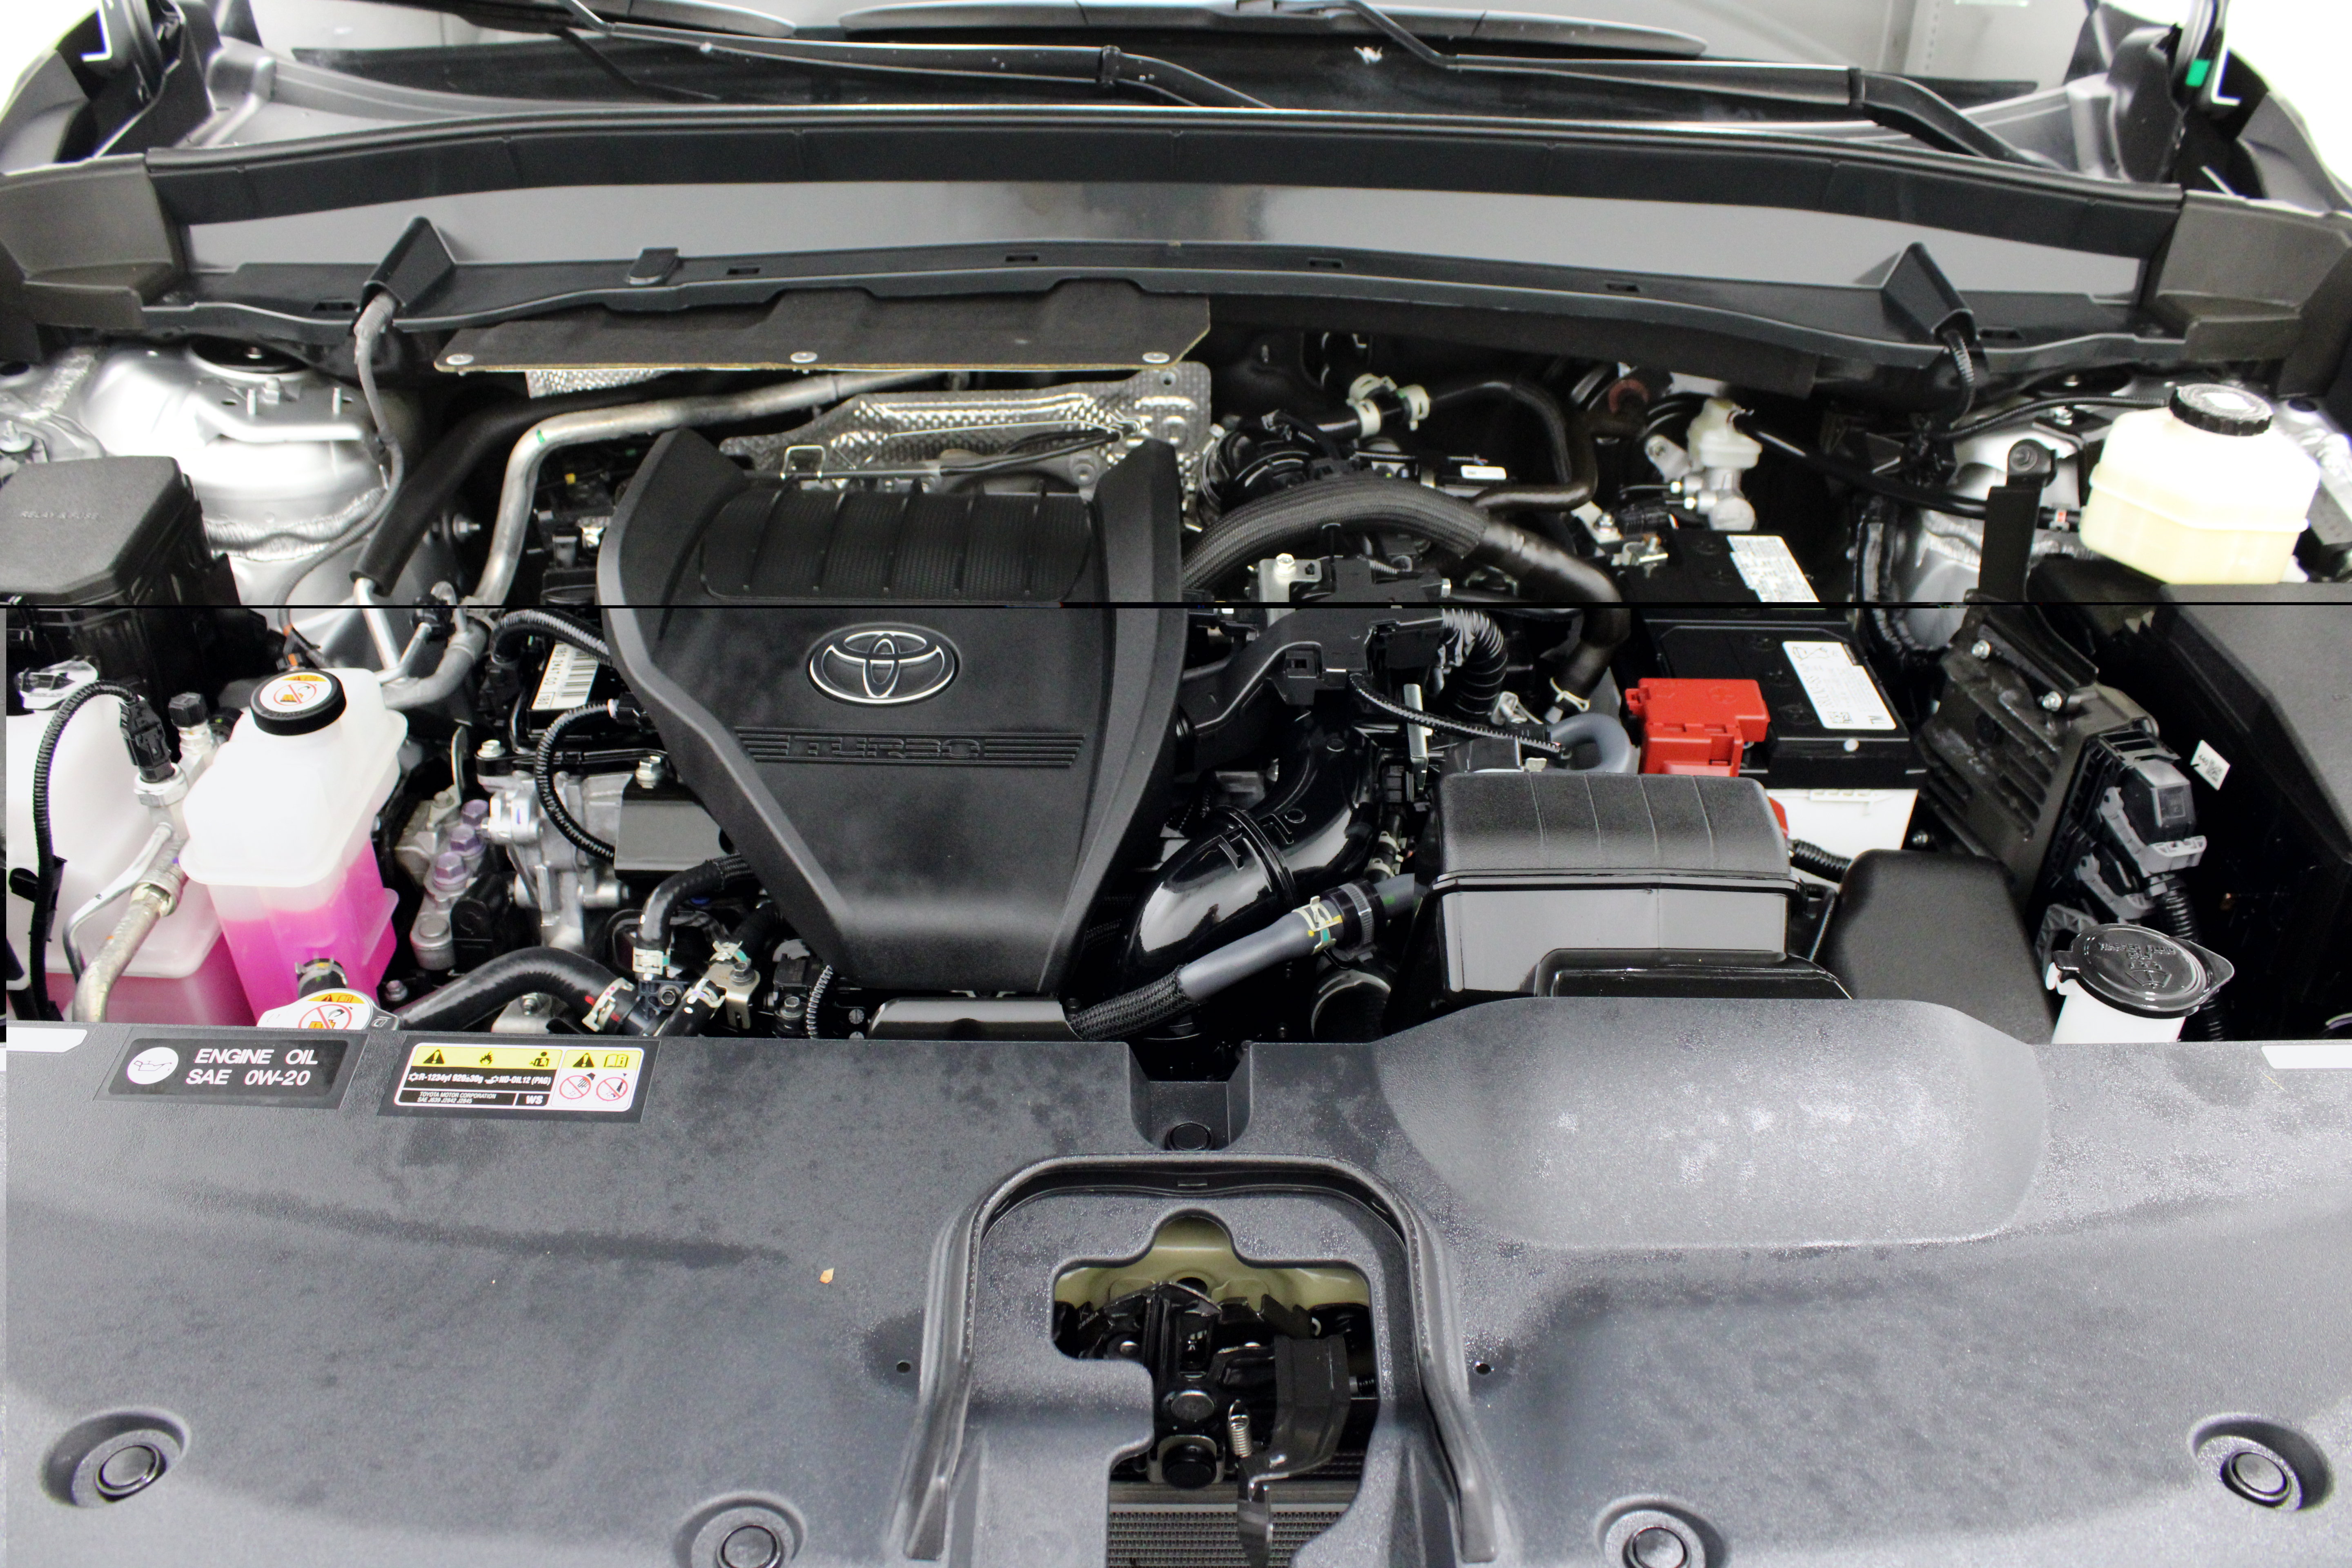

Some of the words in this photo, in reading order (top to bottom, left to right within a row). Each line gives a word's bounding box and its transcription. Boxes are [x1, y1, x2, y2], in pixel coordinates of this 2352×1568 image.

[794, 736, 980, 758] TURBO
[2098, 942, 2140, 952] WASHER
[2147, 944, 2176, 955] FLUID
[2127, 951, 2152, 960] ONLY
[194, 1048, 274, 1064] ENGINE
[285, 1049, 318, 1065] OIL
[186, 1069, 232, 1085] SAE
[244, 1070, 311, 1086] 0W-20
[418, 1073, 451, 1083] R-1234yf
[499, 1076, 530, 1084] ND-OIL12
[531, 1076, 551, 1085] (PAG)
[526, 1095, 543, 1105] WS
